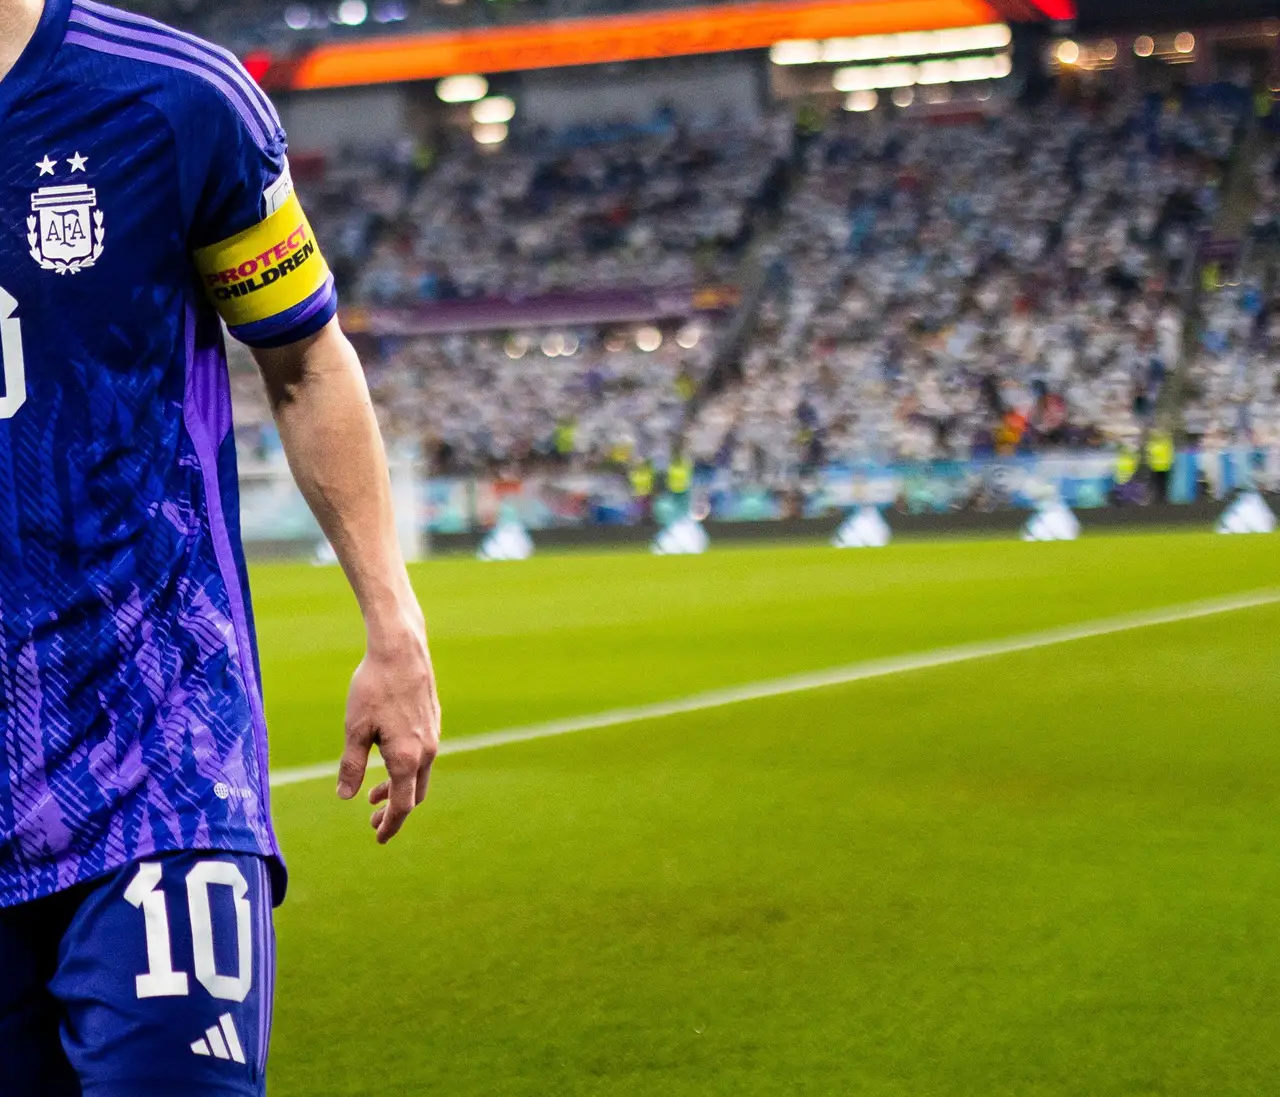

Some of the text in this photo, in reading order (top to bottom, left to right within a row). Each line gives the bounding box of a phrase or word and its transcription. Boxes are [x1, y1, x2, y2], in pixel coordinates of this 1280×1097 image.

[46, 209, 86, 247] AFA
[205, 224, 307, 287] PROTECT
[214, 240, 314, 300] CHILDREN
[124, 861, 252, 1002] 10
